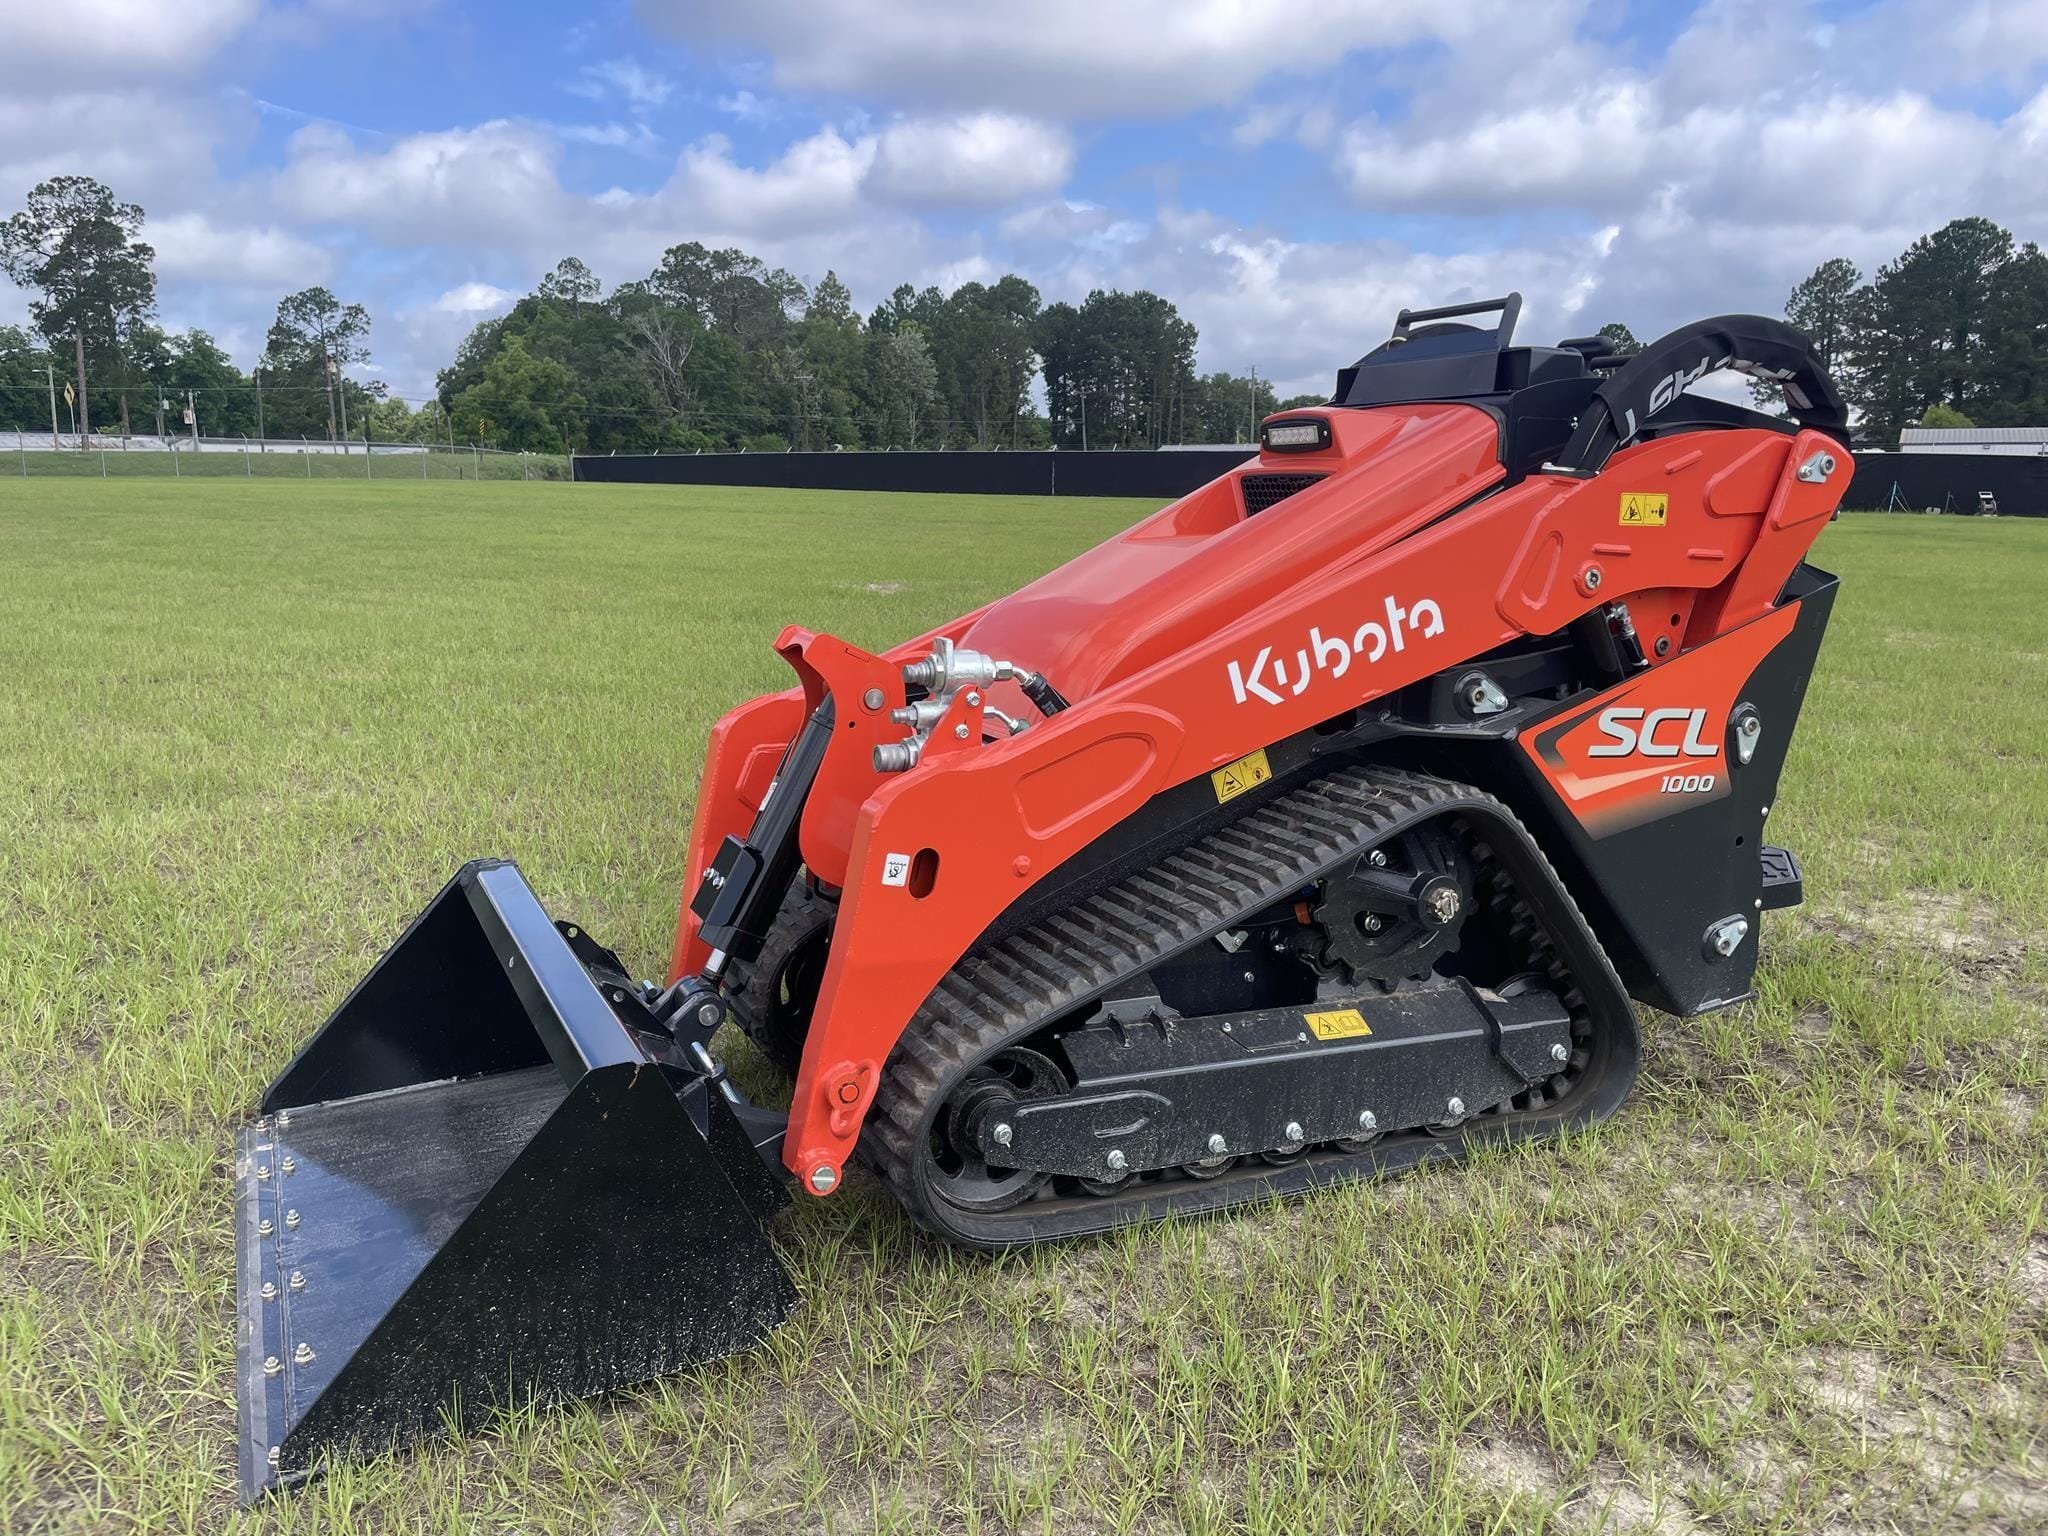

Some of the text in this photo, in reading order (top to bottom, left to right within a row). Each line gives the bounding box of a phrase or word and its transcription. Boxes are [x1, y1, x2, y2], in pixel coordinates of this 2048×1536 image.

[1227, 595, 1445, 706] Kubota
[1587, 707, 1719, 757] SCL
[1660, 775, 1715, 793] 1000
